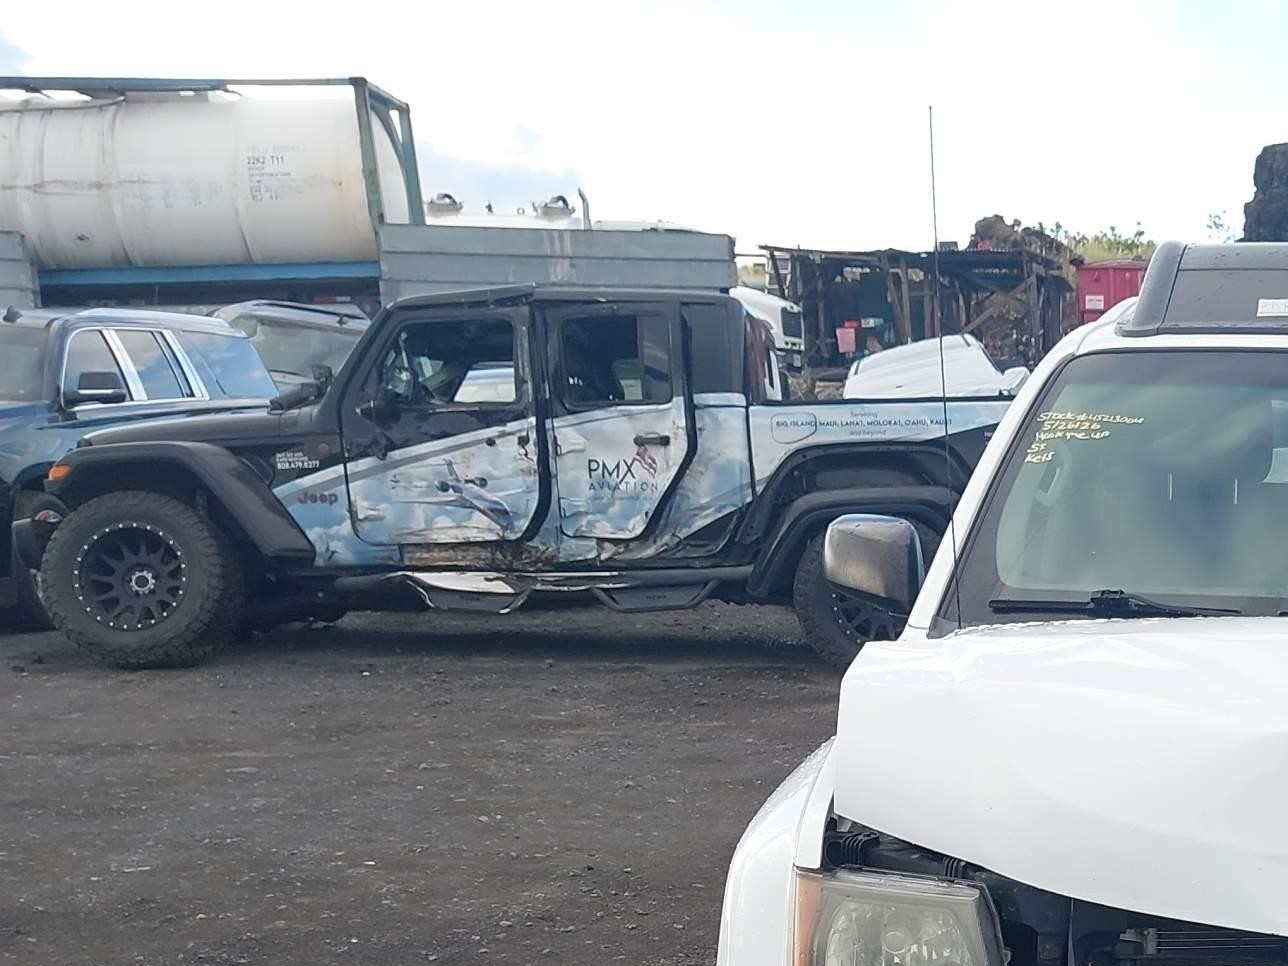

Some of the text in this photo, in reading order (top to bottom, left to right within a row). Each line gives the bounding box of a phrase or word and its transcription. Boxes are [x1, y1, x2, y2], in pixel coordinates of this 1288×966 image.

[587, 457, 636, 485] PMX
[588, 481, 658, 492] AVIATION
[297, 491, 339, 507] Jeep
